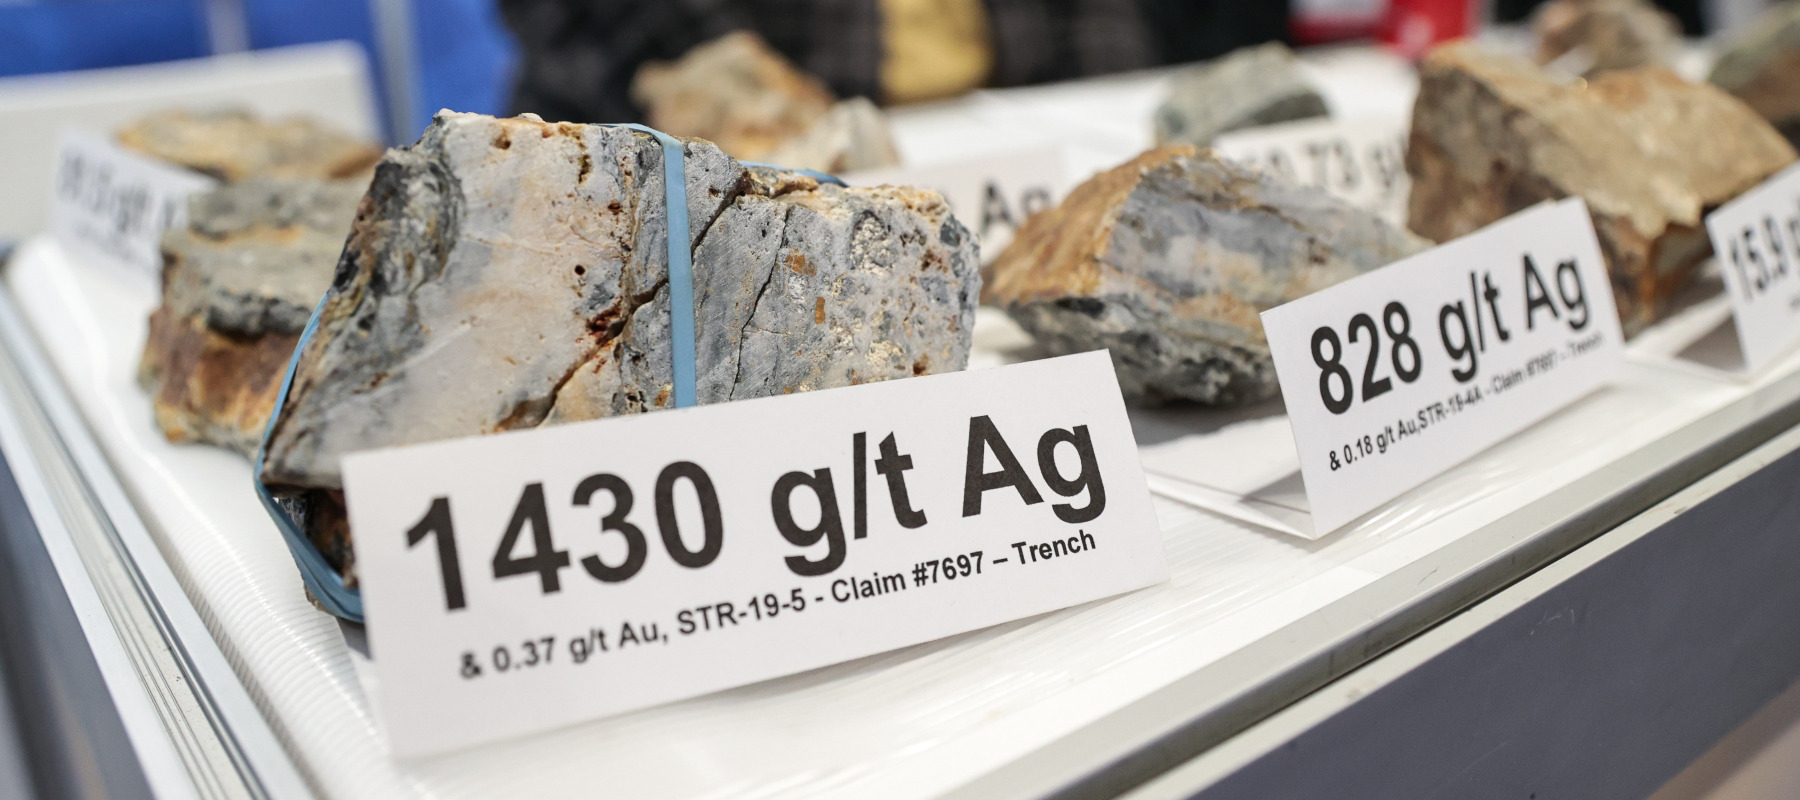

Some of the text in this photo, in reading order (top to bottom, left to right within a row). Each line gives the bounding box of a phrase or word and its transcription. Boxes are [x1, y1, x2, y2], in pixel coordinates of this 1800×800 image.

[1310, 253, 1590, 416] 828 g/t Ag
[404, 414, 1108, 612] 1430 g/t Ag
[1328, 450, 1343, 472] &
[1343, 434, 1375, 465] 0.18
[1376, 425, 1397, 455] g/t
[460, 652, 482, 679] &
[492, 636, 556, 672] 0.37
[569, 627, 608, 664] g/t
[619, 622, 669, 646] Au,
[677, 587, 807, 635] STR-19-5
[831, 571, 907, 603] Claim
[911, 550, 985, 588] #7697
[1010, 529, 1097, 565] Trench
